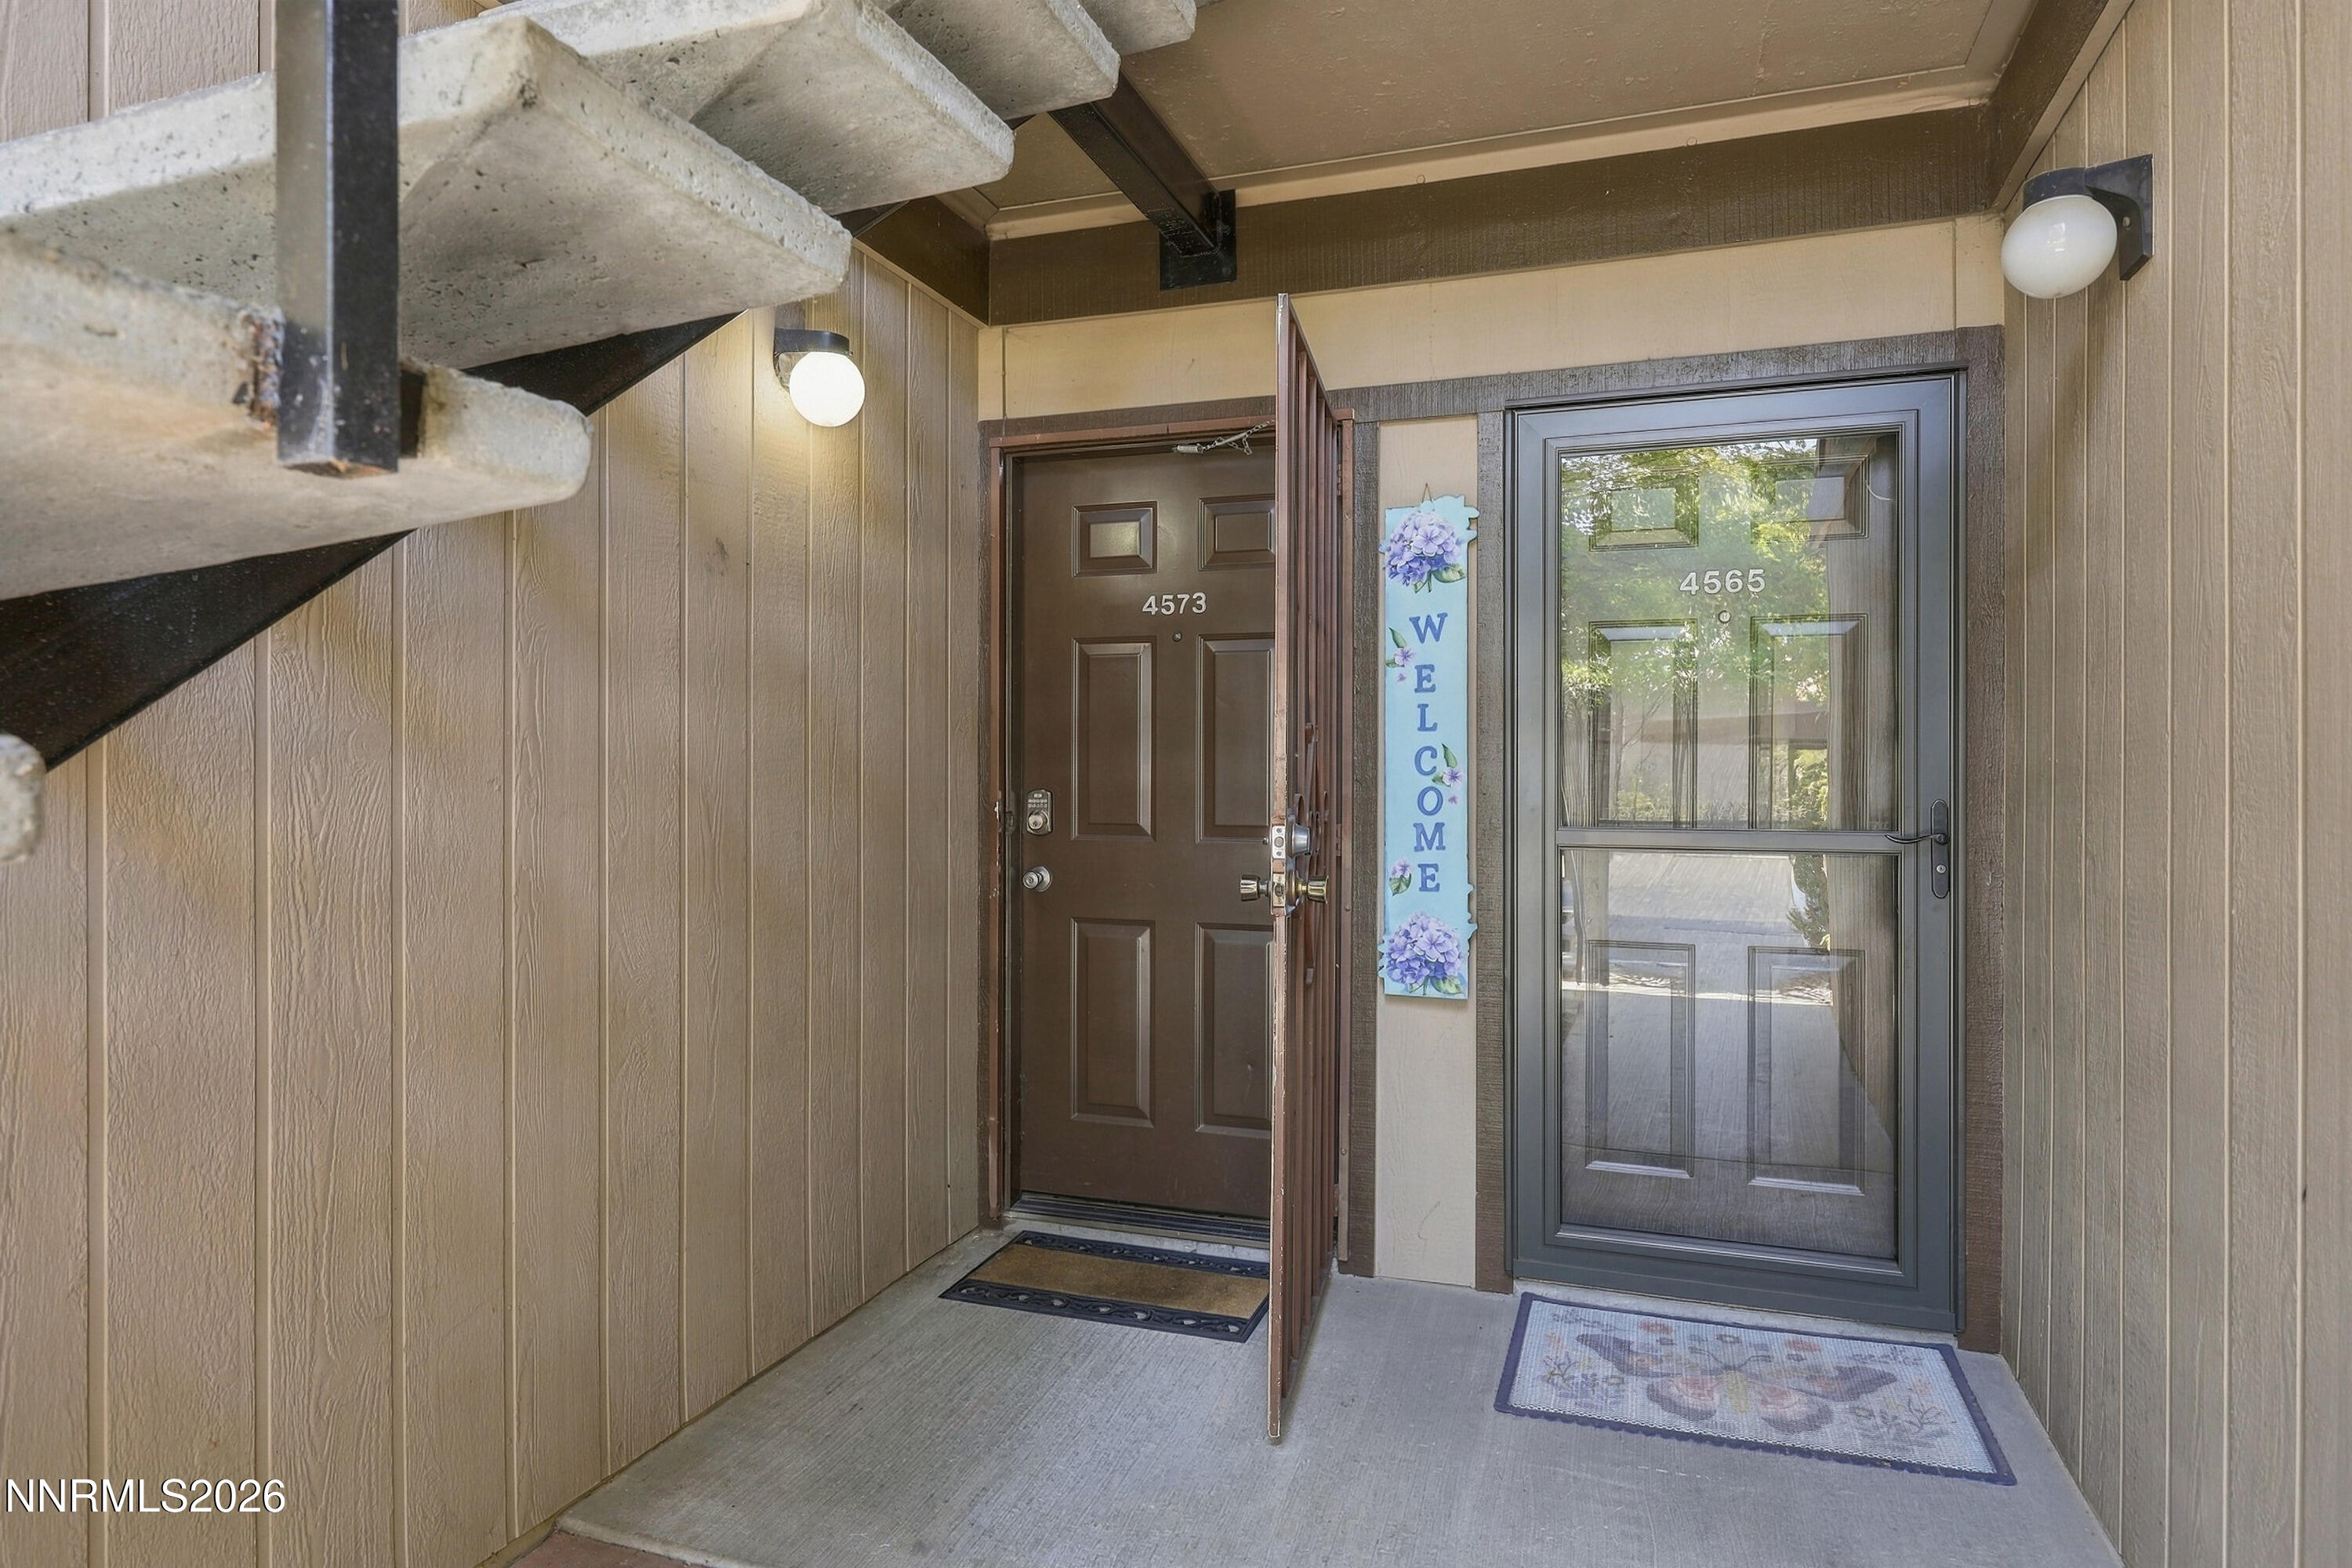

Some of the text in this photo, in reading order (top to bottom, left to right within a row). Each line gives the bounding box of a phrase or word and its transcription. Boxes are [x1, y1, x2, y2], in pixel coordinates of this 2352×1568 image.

[1679, 568, 1766, 595] 4565
[1142, 592, 1207, 615] 4573
[1410, 613, 1448, 893] WELCOME
